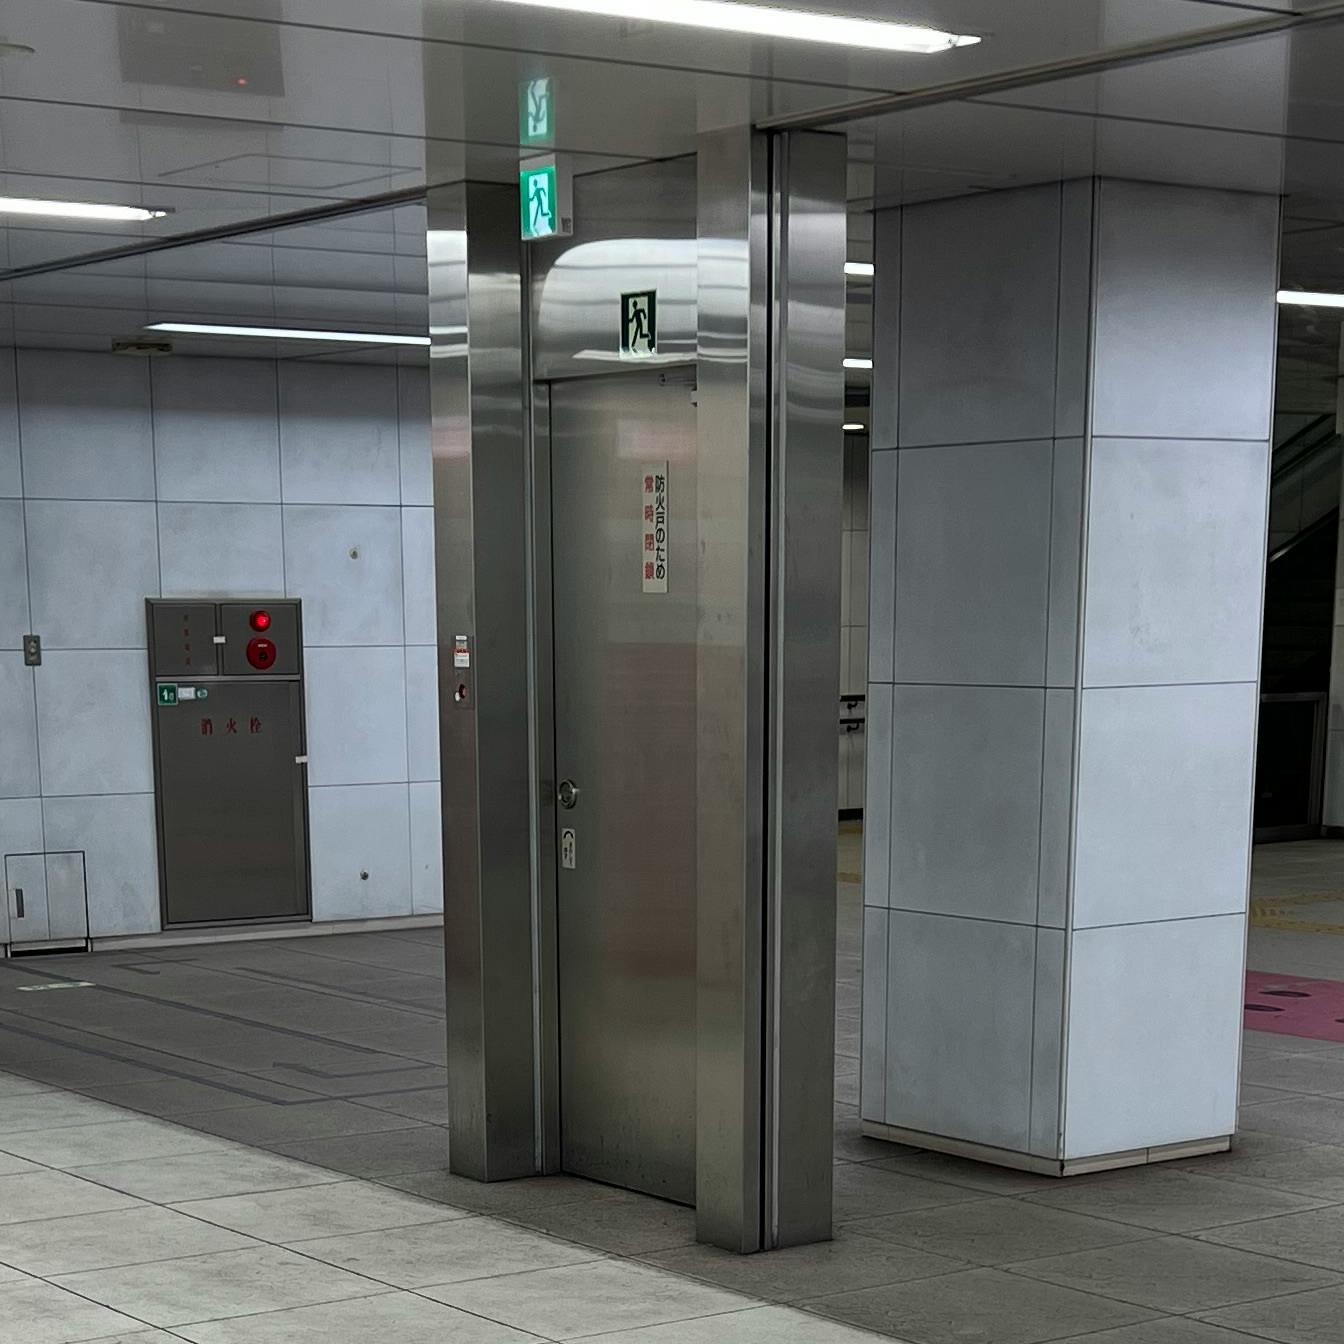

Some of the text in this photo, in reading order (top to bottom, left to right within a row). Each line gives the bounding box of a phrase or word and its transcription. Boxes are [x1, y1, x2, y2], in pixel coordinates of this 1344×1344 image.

[654, 474, 666, 580] 防火戸のため
[200, 717, 262, 735] 消火栓
